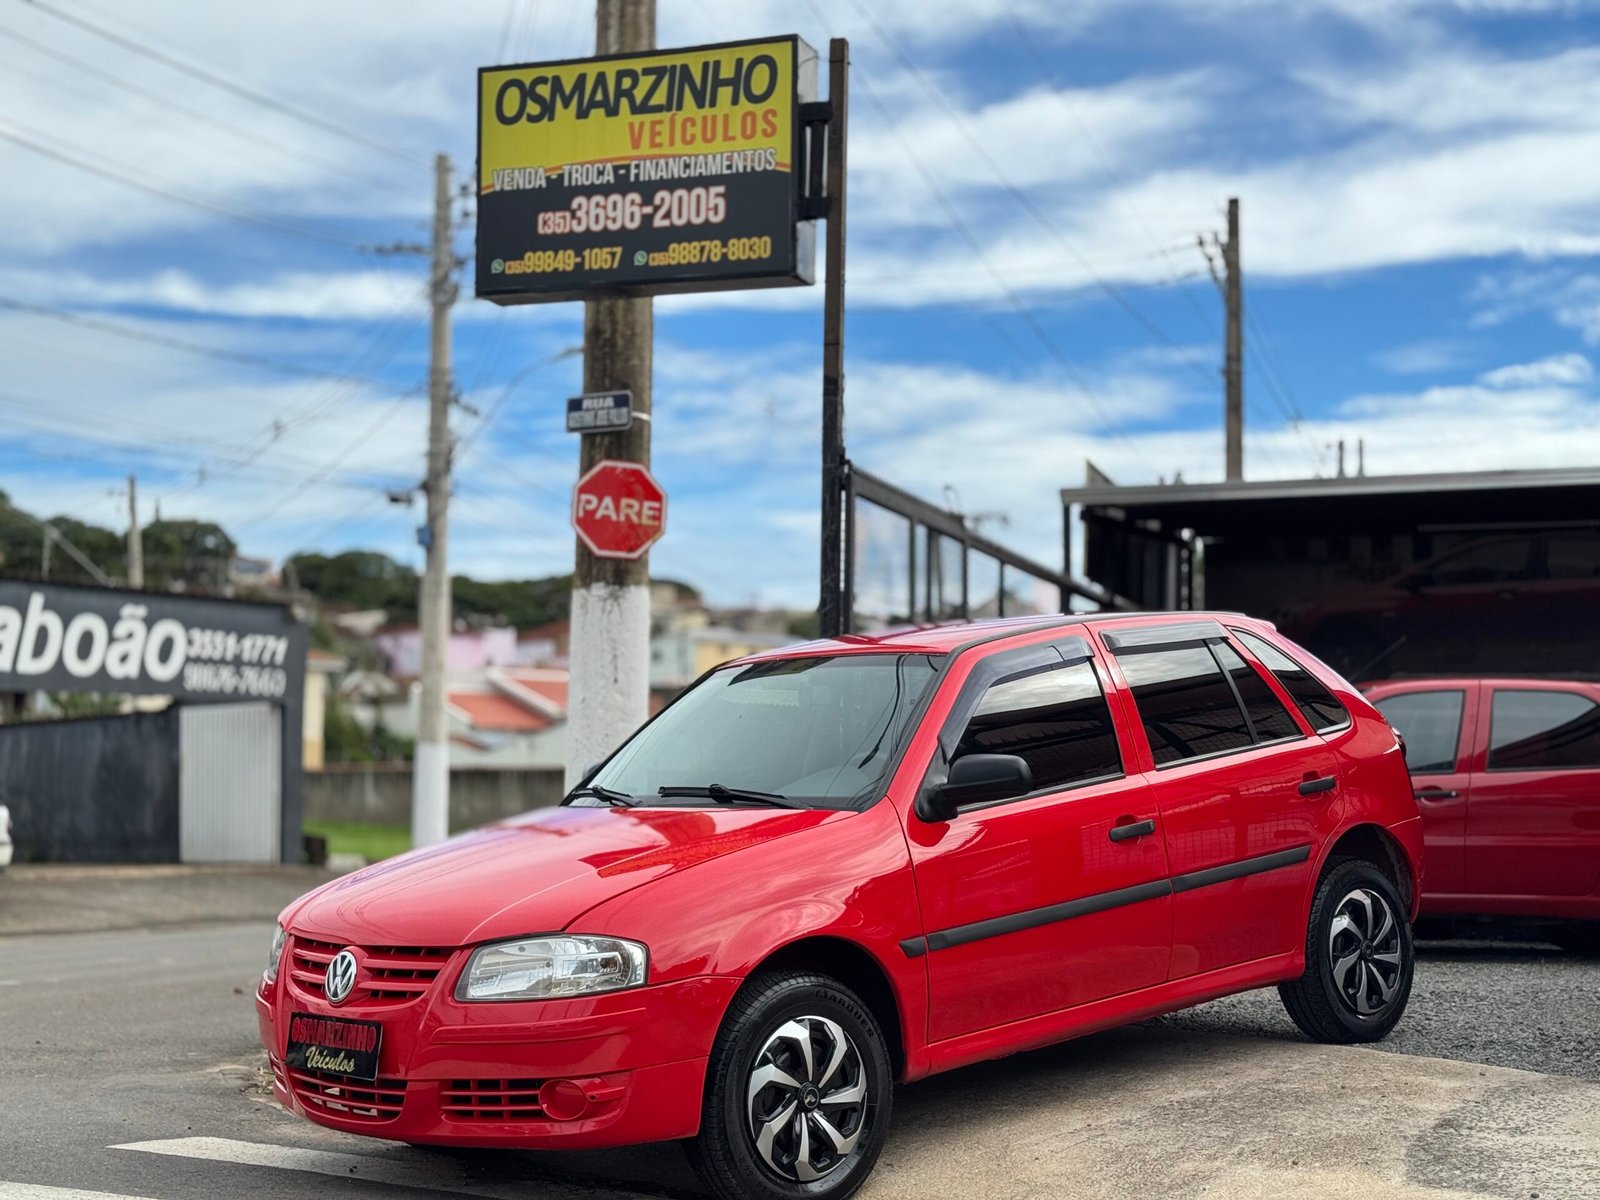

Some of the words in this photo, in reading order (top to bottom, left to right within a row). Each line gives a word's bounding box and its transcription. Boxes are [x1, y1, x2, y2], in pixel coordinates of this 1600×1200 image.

[495, 54, 779, 126] OSMARZINHO
[627, 108, 778, 151] VEÍCULOS
[492, 167, 547, 192] VENDA
[562, 161, 615, 188] TROCA
[629, 148, 777, 183] FINANCIAMENTOS
[577, 493, 661, 526] PARE
[291, 1016, 377, 1053] OSMARZINHO
